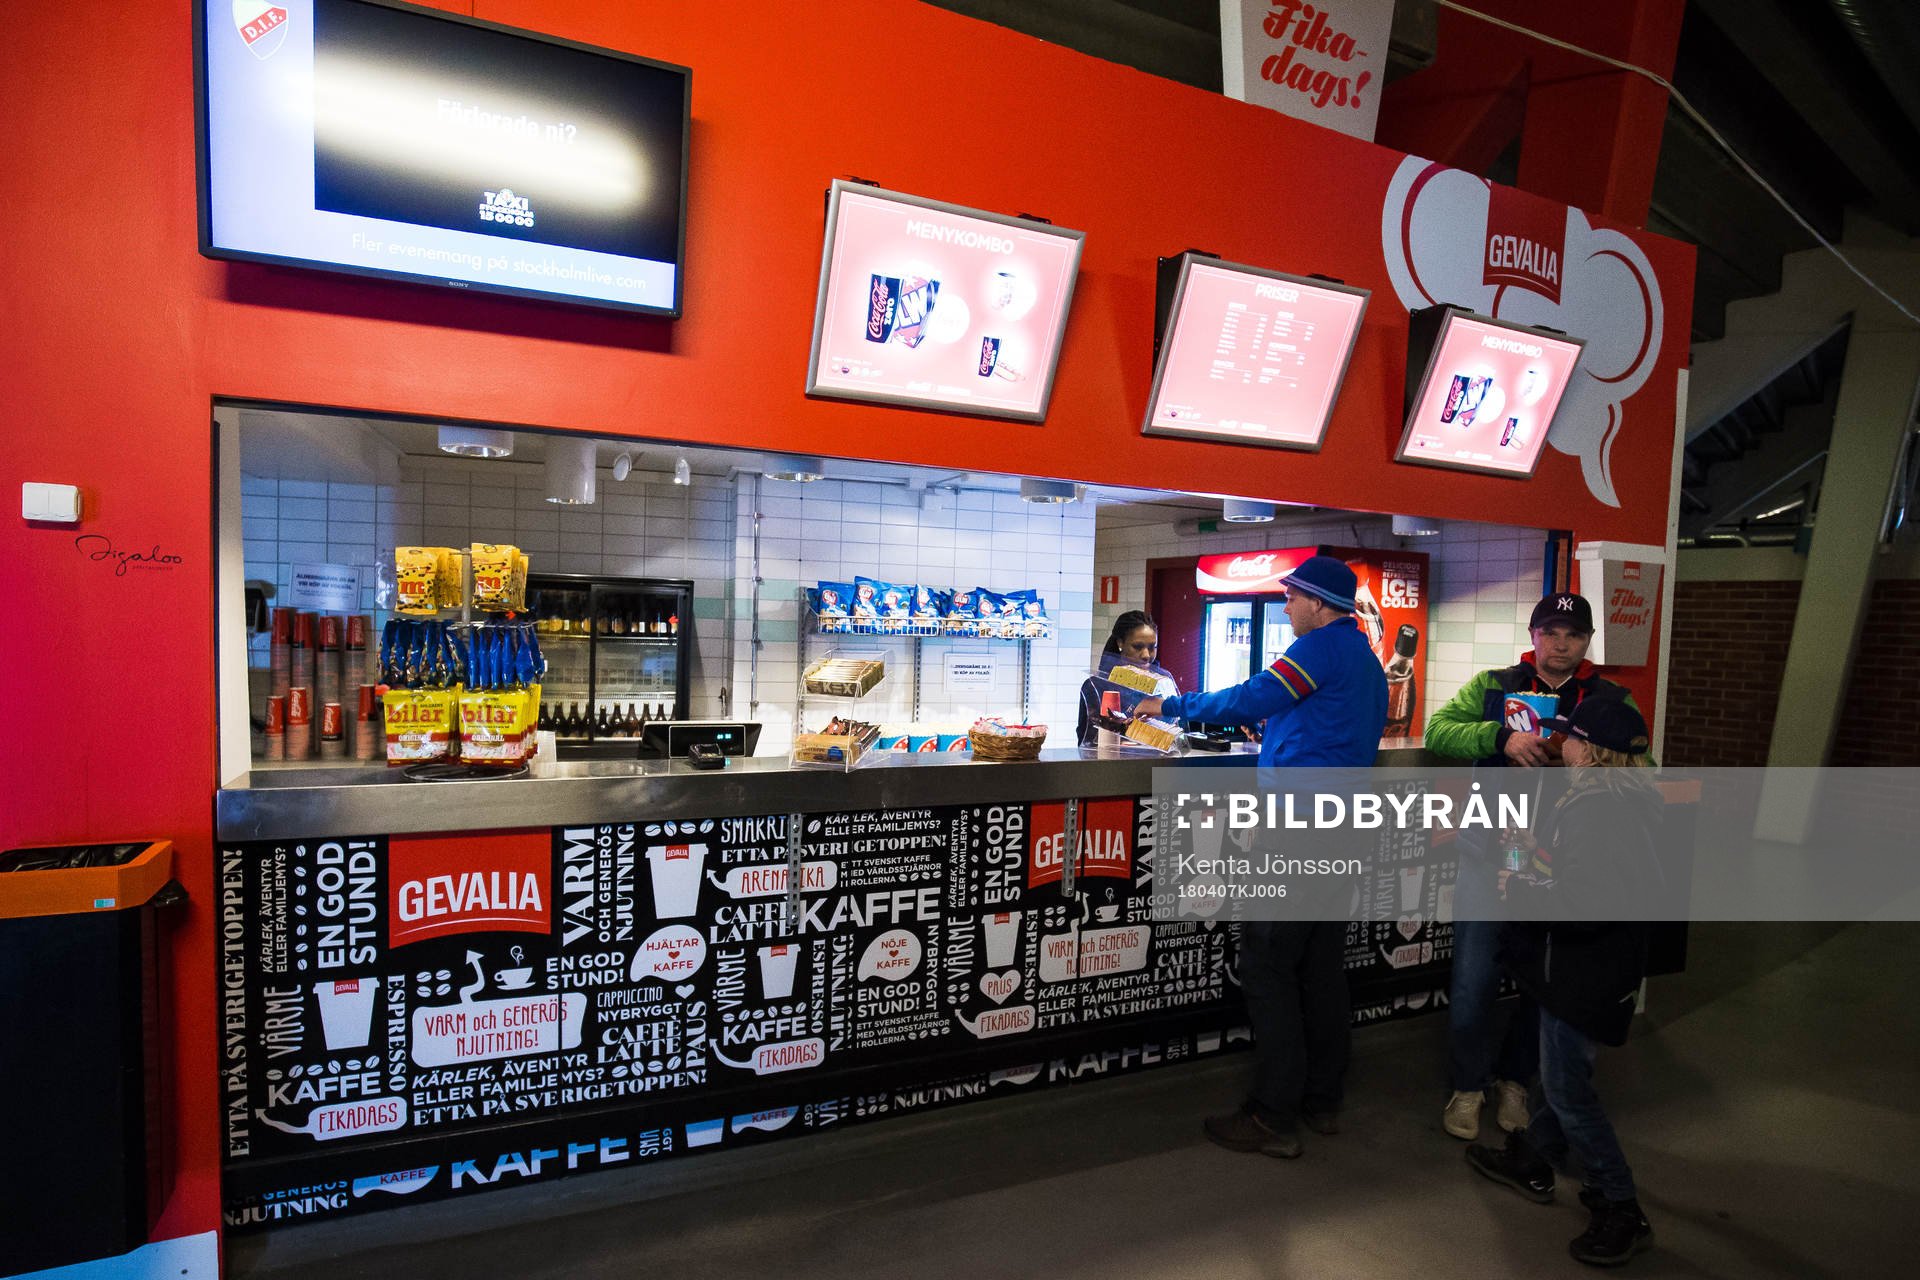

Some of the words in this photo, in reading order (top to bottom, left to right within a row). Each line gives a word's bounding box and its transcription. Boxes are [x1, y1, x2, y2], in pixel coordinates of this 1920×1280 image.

[244, 11, 283, 38] D.I.F.
[1263, 0, 1368, 61] Fika-
[1261, 45, 1372, 109] dags!
[906, 219, 1014, 255] MENYKOMBO
[352, 233, 382, 253] Fler
[388, 239, 482, 271] evenemang
[487, 255, 508, 272] på
[513, 260, 647, 290] stockholmlive.com
[1489, 234, 1558, 286] GEVALIA
[1255, 283, 1299, 303] PRISER
[1381, 596, 1418, 608] COLD
[1382, 578, 1419, 597] ICE
[387, 704, 444, 723] bilar
[462, 704, 517, 724] bilar
[721, 814, 806, 844] SMAKRI
[825, 824, 865, 836] ELLER
[868, 820, 941, 833] FAMILJEMYS?
[949, 819, 959, 865] ÄVENTYR
[959, 809, 968, 876] FAMILJEMYS?
[986, 806, 1004, 864] GOD
[1136, 796, 1159, 889] VARM
[597, 825, 613, 903] GENERÖS
[721, 848, 769, 863] ETTA
[800, 834, 947, 857] SVERIGETOPPEN!
[841, 860, 863, 869] ETT
[864, 857, 902, 866] SVENSKT
[904, 854, 931, 863] KAFFE
[1003, 805, 1024, 901] STUND!
[1035, 829, 1126, 868] GEALIA
[316, 842, 345, 917] GOD
[616, 824, 635, 942] NJUTNING
[741, 866, 825, 894] ARENAIKA
[846, 876, 896, 887] ROLLERNA
[867, 863, 942, 876] VÄRLDSSTJÄRNOR
[259, 858, 273, 917] ÄVENTYR
[275, 847, 287, 932] FAMILJEMYS?
[399, 871, 542, 922] GEVALIA
[562, 826, 595, 947] VARM
[984, 869, 1003, 904] EN
[1127, 896, 1145, 909] EN
[1147, 893, 1175, 907] GOD
[349, 842, 377, 965] STUND!
[798, 887, 941, 934] KAFFE
[1127, 906, 1175, 923] STUND!
[598, 908, 611, 943] OCH
[709, 919, 793, 944] LATTE
[1155, 921, 1198, 938] CAPPUCCINO
[222, 849, 247, 1059] SVERIGETOPPEN!
[259, 920, 275, 974] KÄRLEK,
[276, 934, 288, 973] ELLER
[317, 924, 345, 969] EN
[646, 938, 699, 951] HJÄLTAR
[881, 938, 907, 949] NÖJE
[943, 915, 976, 980] VÄRME
[1024, 909, 1039, 1001] ESPRESSO
[1047, 939, 1074, 958] VARM
[1080, 938, 1096, 953] och
[1099, 930, 1139, 950] GENERÖS
[1155, 934, 1209, 950] NYBRYGGT
[546, 956, 574, 973] EN
[578, 952, 625, 969] GOD
[653, 959, 694, 972] KAFFE
[876, 958, 910, 970] KAFFE
[926, 924, 939, 1010] NYBRYGGT
[1153, 963, 1208, 982] LATTE
[1209, 933, 1225, 987] PAUS
[546, 968, 625, 990] STUND!
[712, 948, 747, 1012] VÄRME
[811, 939, 826, 1034] ESPRESSO
[857, 986, 880, 1002] EN
[883, 982, 921, 998] GOD
[987, 978, 1012, 996] PAUS
[1038, 982, 1093, 1000] KÄRLEK,
[1096, 973, 1150, 991] ÄVENTYR
[597, 986, 664, 1008] CAPPUCCINO
[597, 1002, 682, 1023] NYBRYGGT
[857, 998, 920, 1018] STUND!
[1037, 1011, 1076, 1029] ETTA
[1083, 1004, 1101, 1022] PÅ
[1103, 987, 1222, 1018] SVERIGETOPPEN!
[1038, 997, 1076, 1013] ELLER
[1082, 985, 1159, 1006] FAMILJEMYS?
[259, 984, 305, 1059] VÄRME
[387, 975, 406, 1092] ESPRESSO
[425, 1013, 466, 1037] VARM
[473, 1009, 497, 1031] och
[503, 999, 568, 1027] GENERÖS
[723, 1015, 807, 1046] KAFFE
[856, 1030, 875, 1040] MED
[876, 1019, 950, 1037] VÄRLDSSTJÄRNOR
[857, 1022, 872, 1030] ETT
[874, 1017, 911, 1028] SVENSKT
[913, 1012, 939, 1021] KAFFE
[980, 1010, 1030, 1034] FIKADAGS
[456, 1029, 539, 1057] NJUTNING!
[685, 1001, 707, 1068] PAUS
[861, 1035, 906, 1048] ROLLERNA
[597, 1037, 681, 1064] LATTE
[759, 1042, 818, 1069] FIKADAGS
[221, 1062, 247, 1092] PÅ
[411, 1065, 496, 1089] KÄRLEK,
[502, 1053, 588, 1077] ÄVENTYR
[268, 1071, 381, 1108] KAFFE
[413, 1086, 474, 1106] ELLER
[480, 1068, 605, 1096] FAMILJEMYS?
[414, 1104, 477, 1127] ETTA
[483, 1094, 511, 1116] PÅ
[515, 1069, 707, 1111] SVERIGETOPPEN!
[894, 1080, 987, 1110] NJUTNING
[229, 1096, 250, 1158] ETTA
[319, 1102, 398, 1133] FIKADAGS
[751, 1109, 789, 1123] KAFFE
[380, 1168, 427, 1185] KAFFE
[451, 1137, 630, 1189] KAFFE
[223, 1191, 349, 1227] NJUTNING
